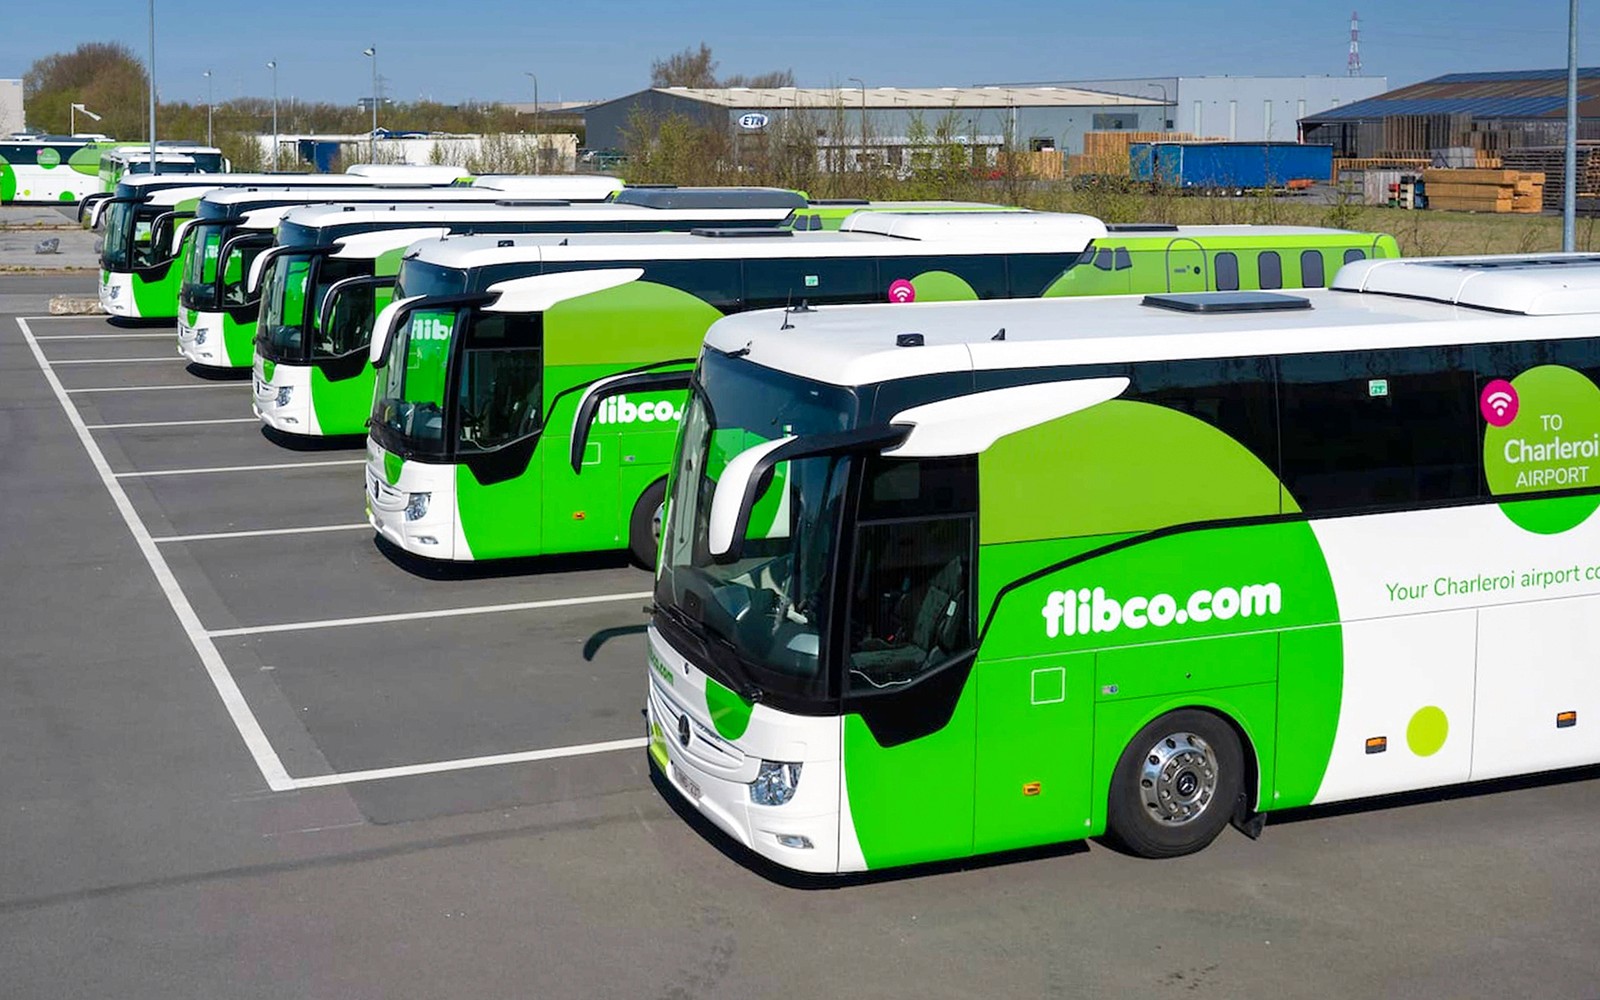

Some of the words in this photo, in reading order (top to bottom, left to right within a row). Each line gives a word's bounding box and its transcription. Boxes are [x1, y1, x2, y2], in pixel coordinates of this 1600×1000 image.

[592, 394, 685, 424] libco.
[1540, 414, 1563, 431] TO
[1504, 433, 1599, 463] Charleroi
[1515, 466, 1589, 488] AIRPORT
[1386, 582, 1428, 601] Your
[1434, 570, 1515, 597] Charleroi
[1520, 565, 1580, 589] airport
[1042, 582, 1282, 638] flibco.com
